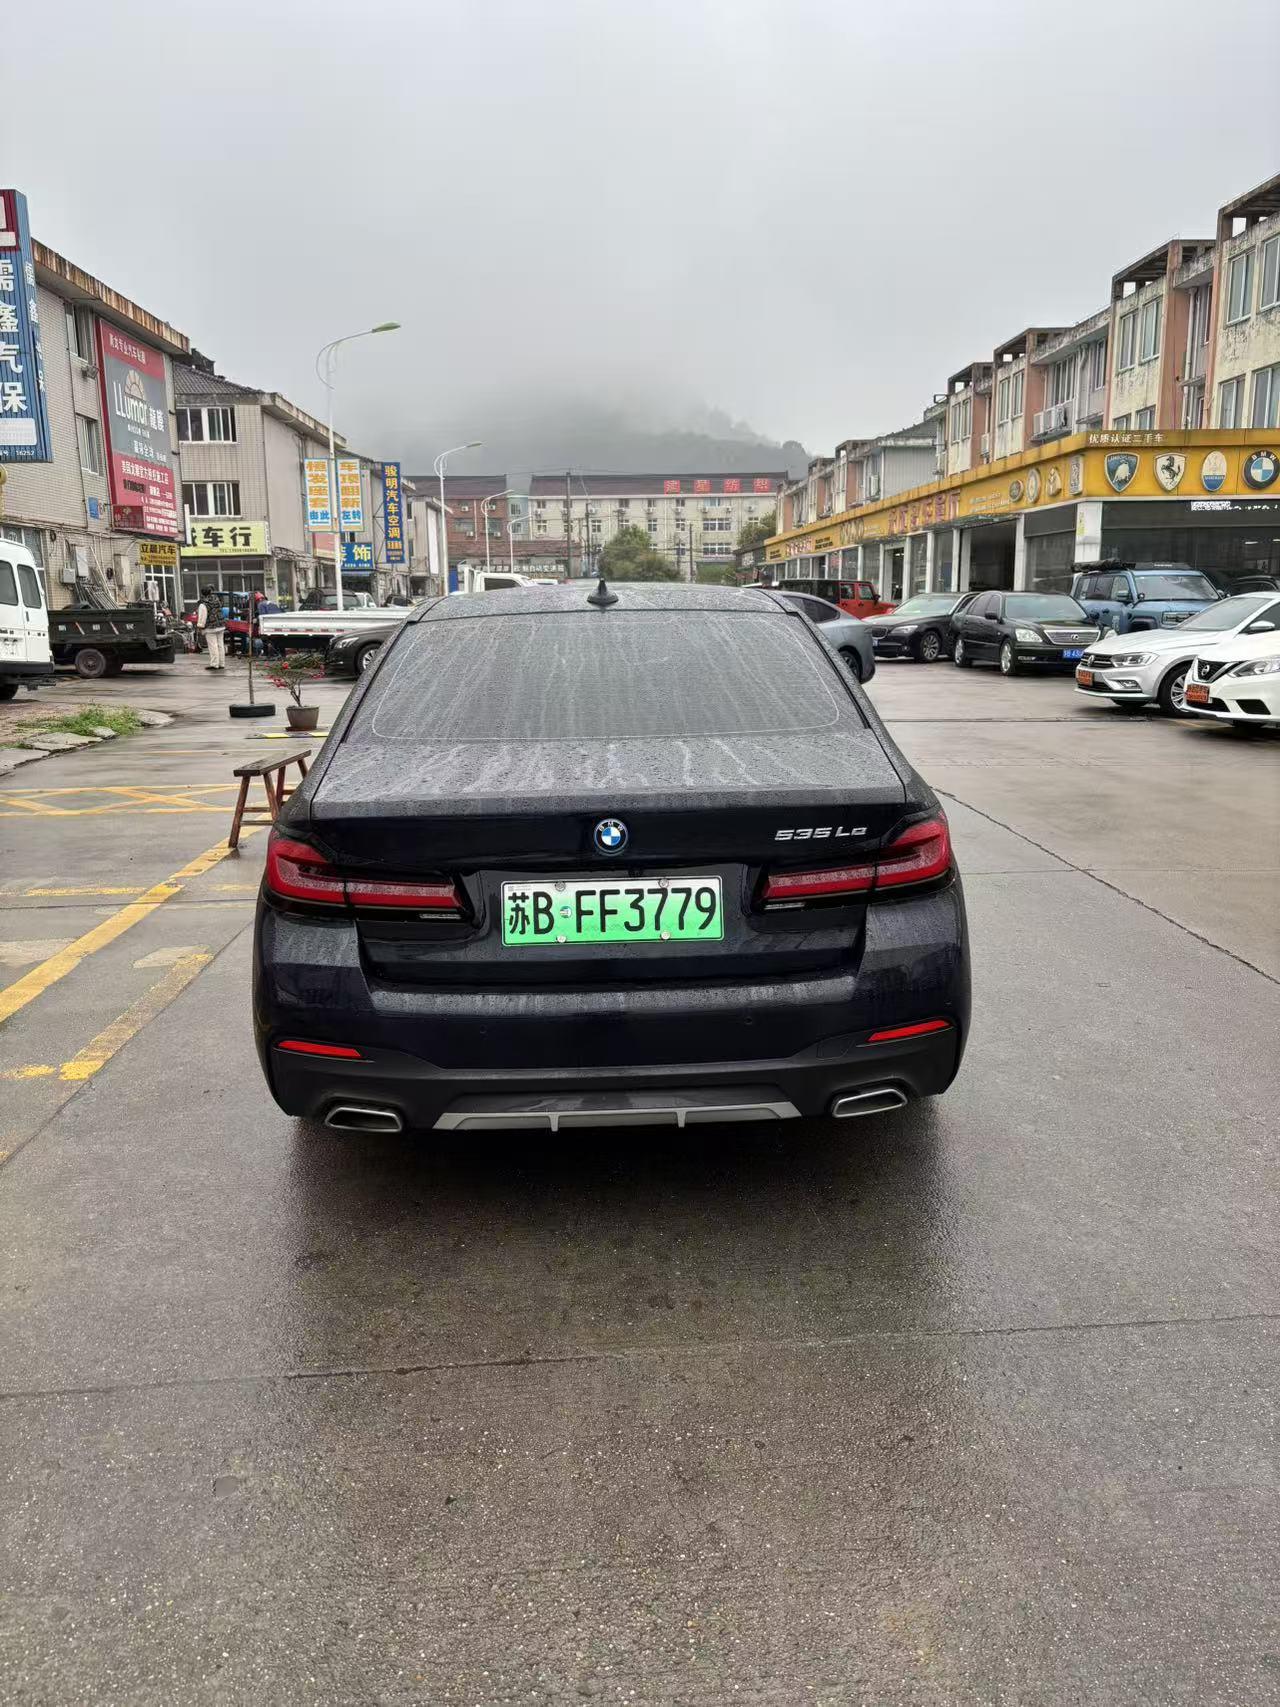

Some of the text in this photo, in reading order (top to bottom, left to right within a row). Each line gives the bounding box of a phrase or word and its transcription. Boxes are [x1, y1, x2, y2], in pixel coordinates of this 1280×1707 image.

[1089, 433, 1163, 444] 优质认证二手车
[384, 465, 402, 539] 骏明汽车空调
[342, 510, 361, 520] 左转
[598, 820, 626, 832] BMW
